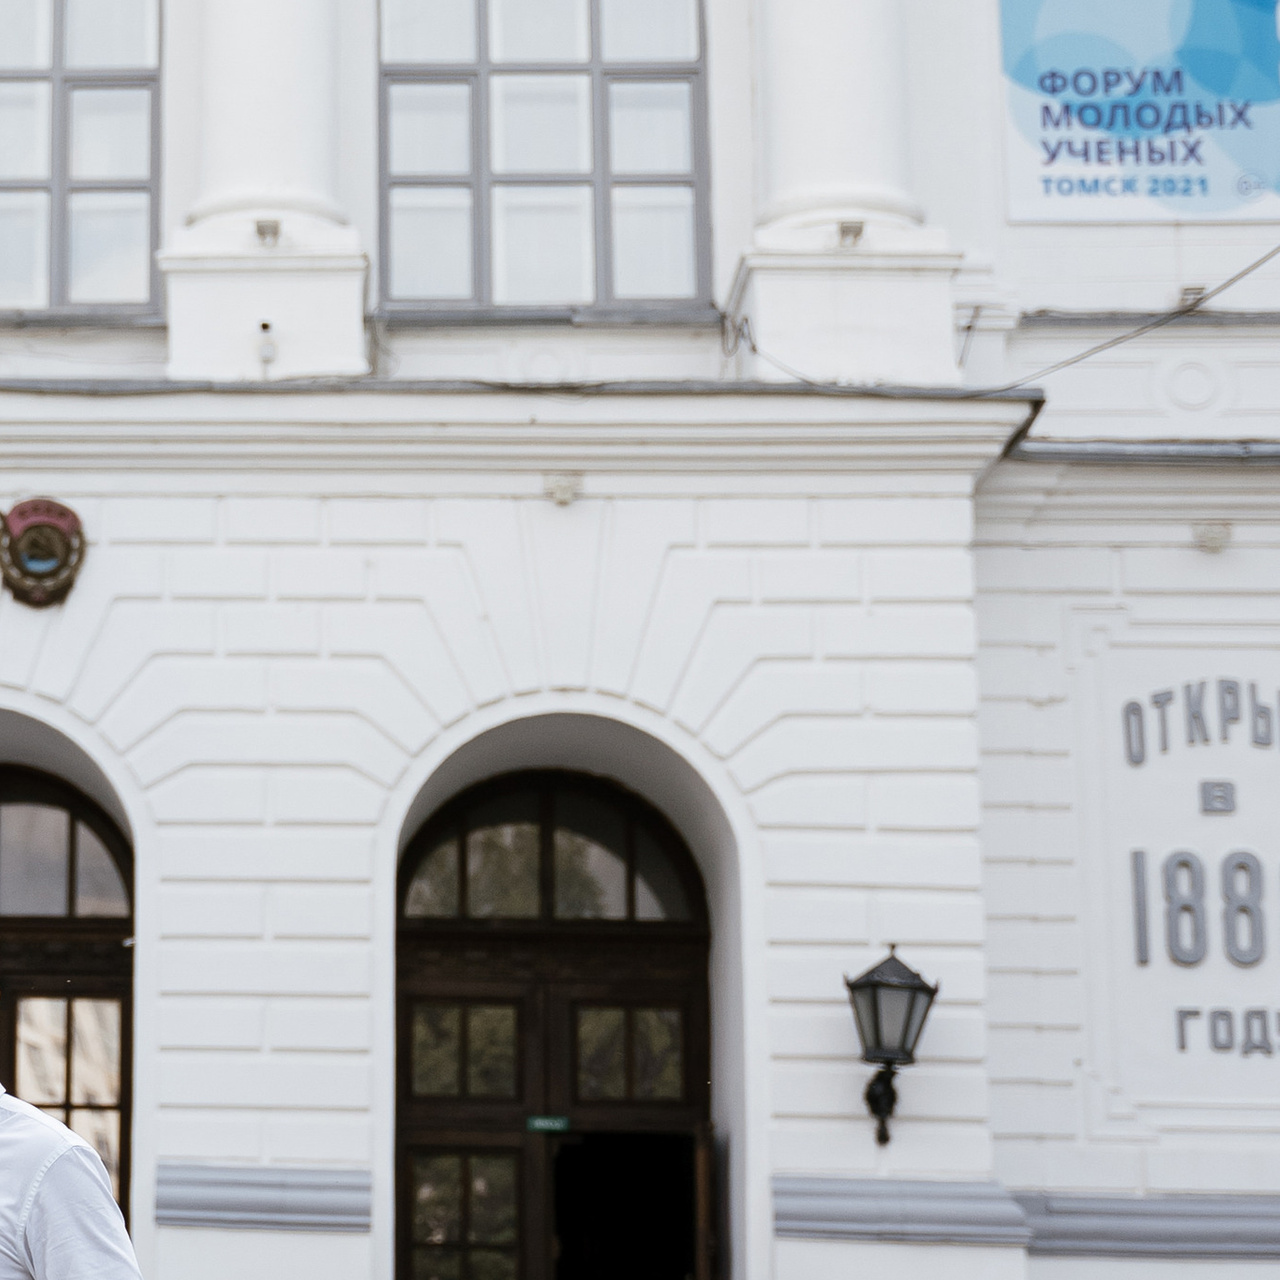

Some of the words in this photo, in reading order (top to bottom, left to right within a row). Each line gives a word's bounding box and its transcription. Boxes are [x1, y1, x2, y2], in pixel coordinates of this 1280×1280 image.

[1038, 69, 1183, 95] ФОРУМ
[1040, 101, 1253, 136] МОЛОДЫХ
[1041, 139, 1204, 165] УЧЕНЫХ
[1041, 176, 1137, 196] ТОМСК
[1147, 176, 1209, 196] 2021
[1132, 851, 1280, 966] 188
[1177, 1010, 1280, 1054] ГОД
